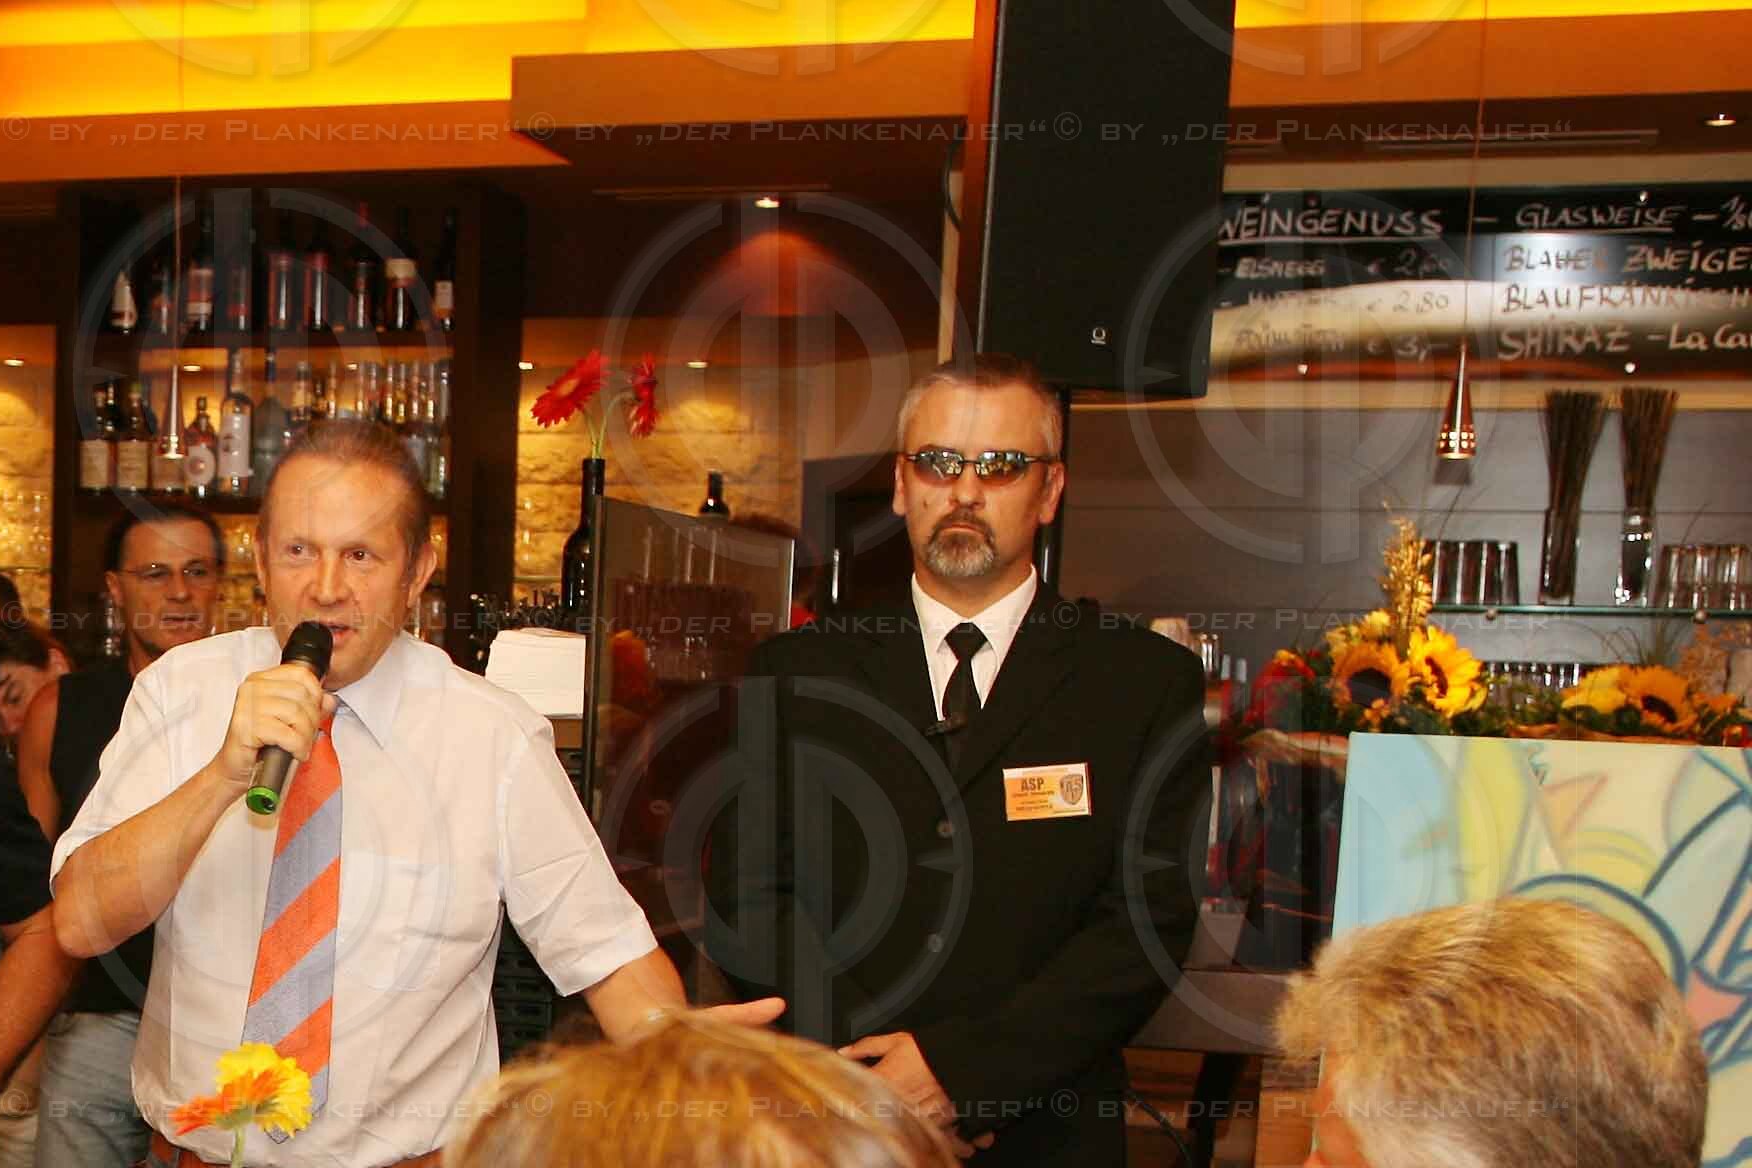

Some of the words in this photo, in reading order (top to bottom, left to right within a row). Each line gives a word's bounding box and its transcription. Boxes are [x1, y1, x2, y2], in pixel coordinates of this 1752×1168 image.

[1515, 202, 1686, 227] GLASWEISE
[1624, 240, 1752, 273] ZWEIGE
[1500, 314, 1632, 361] SHIRAZ
[1021, 778, 1045, 791] ASP
